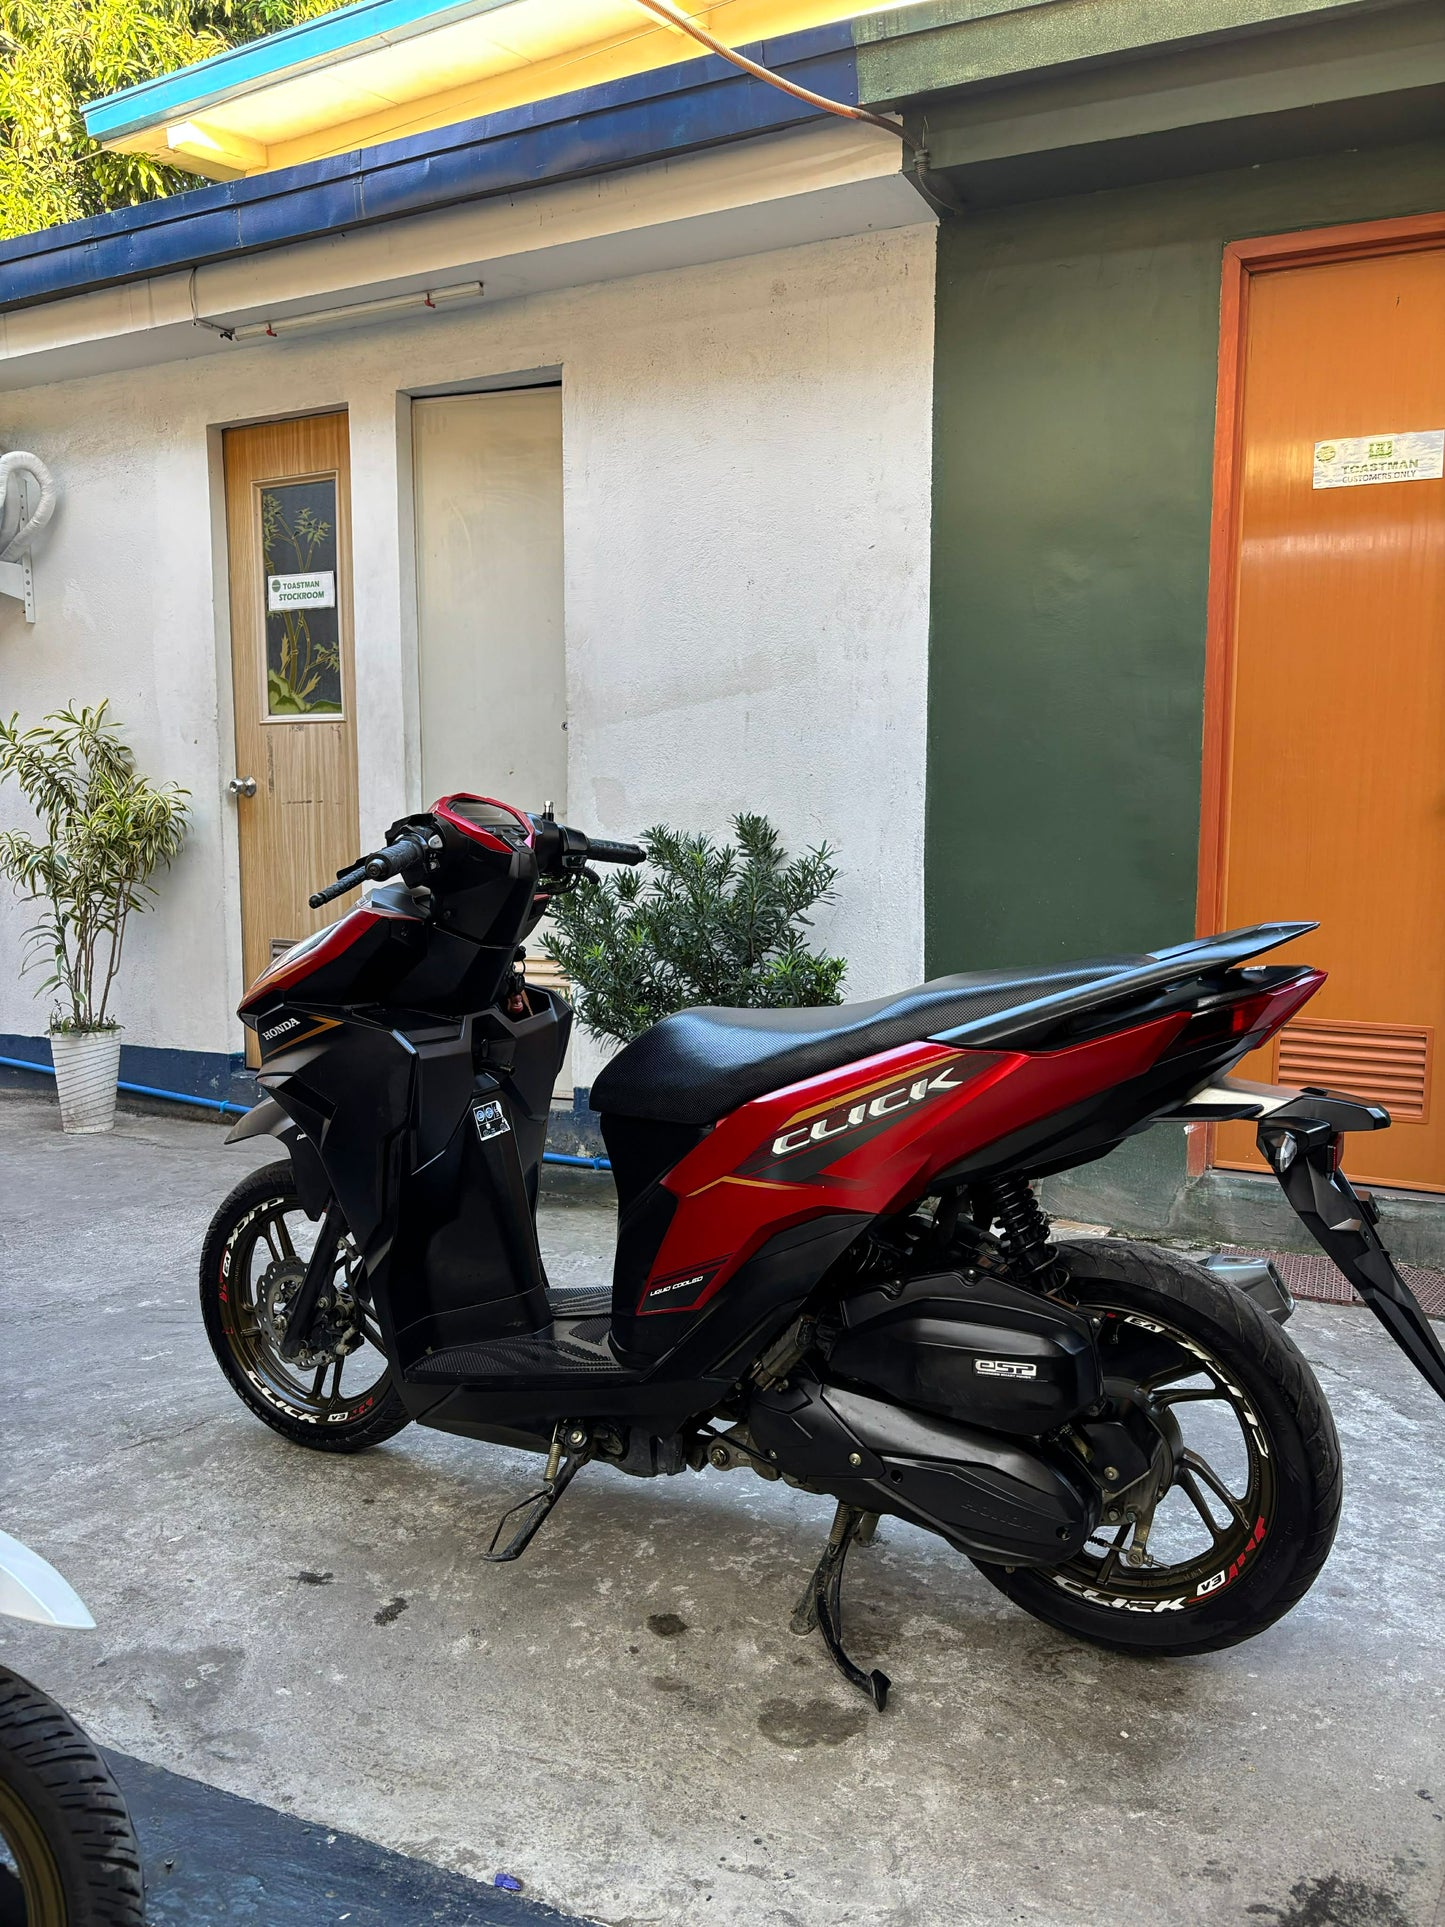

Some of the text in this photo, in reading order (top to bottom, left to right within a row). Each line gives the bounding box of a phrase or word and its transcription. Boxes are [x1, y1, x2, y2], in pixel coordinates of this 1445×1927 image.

[1341, 459, 1419, 475] TOASTMAN
[1342, 470, 1417, 484] CUSTOMERS ONLY
[282, 580, 320, 590] TOASTMAN
[279, 591, 325, 601] STOCKROOM
[262, 1017, 301, 1041] HONDA
[771, 1067, 964, 1157] CLICK
[227, 1197, 285, 1249] CLICK
[672, 1275, 704, 1290] COOLED
[247, 1370, 347, 1424] CLICK V3
[1053, 1575, 1225, 1613] CLICK V3
